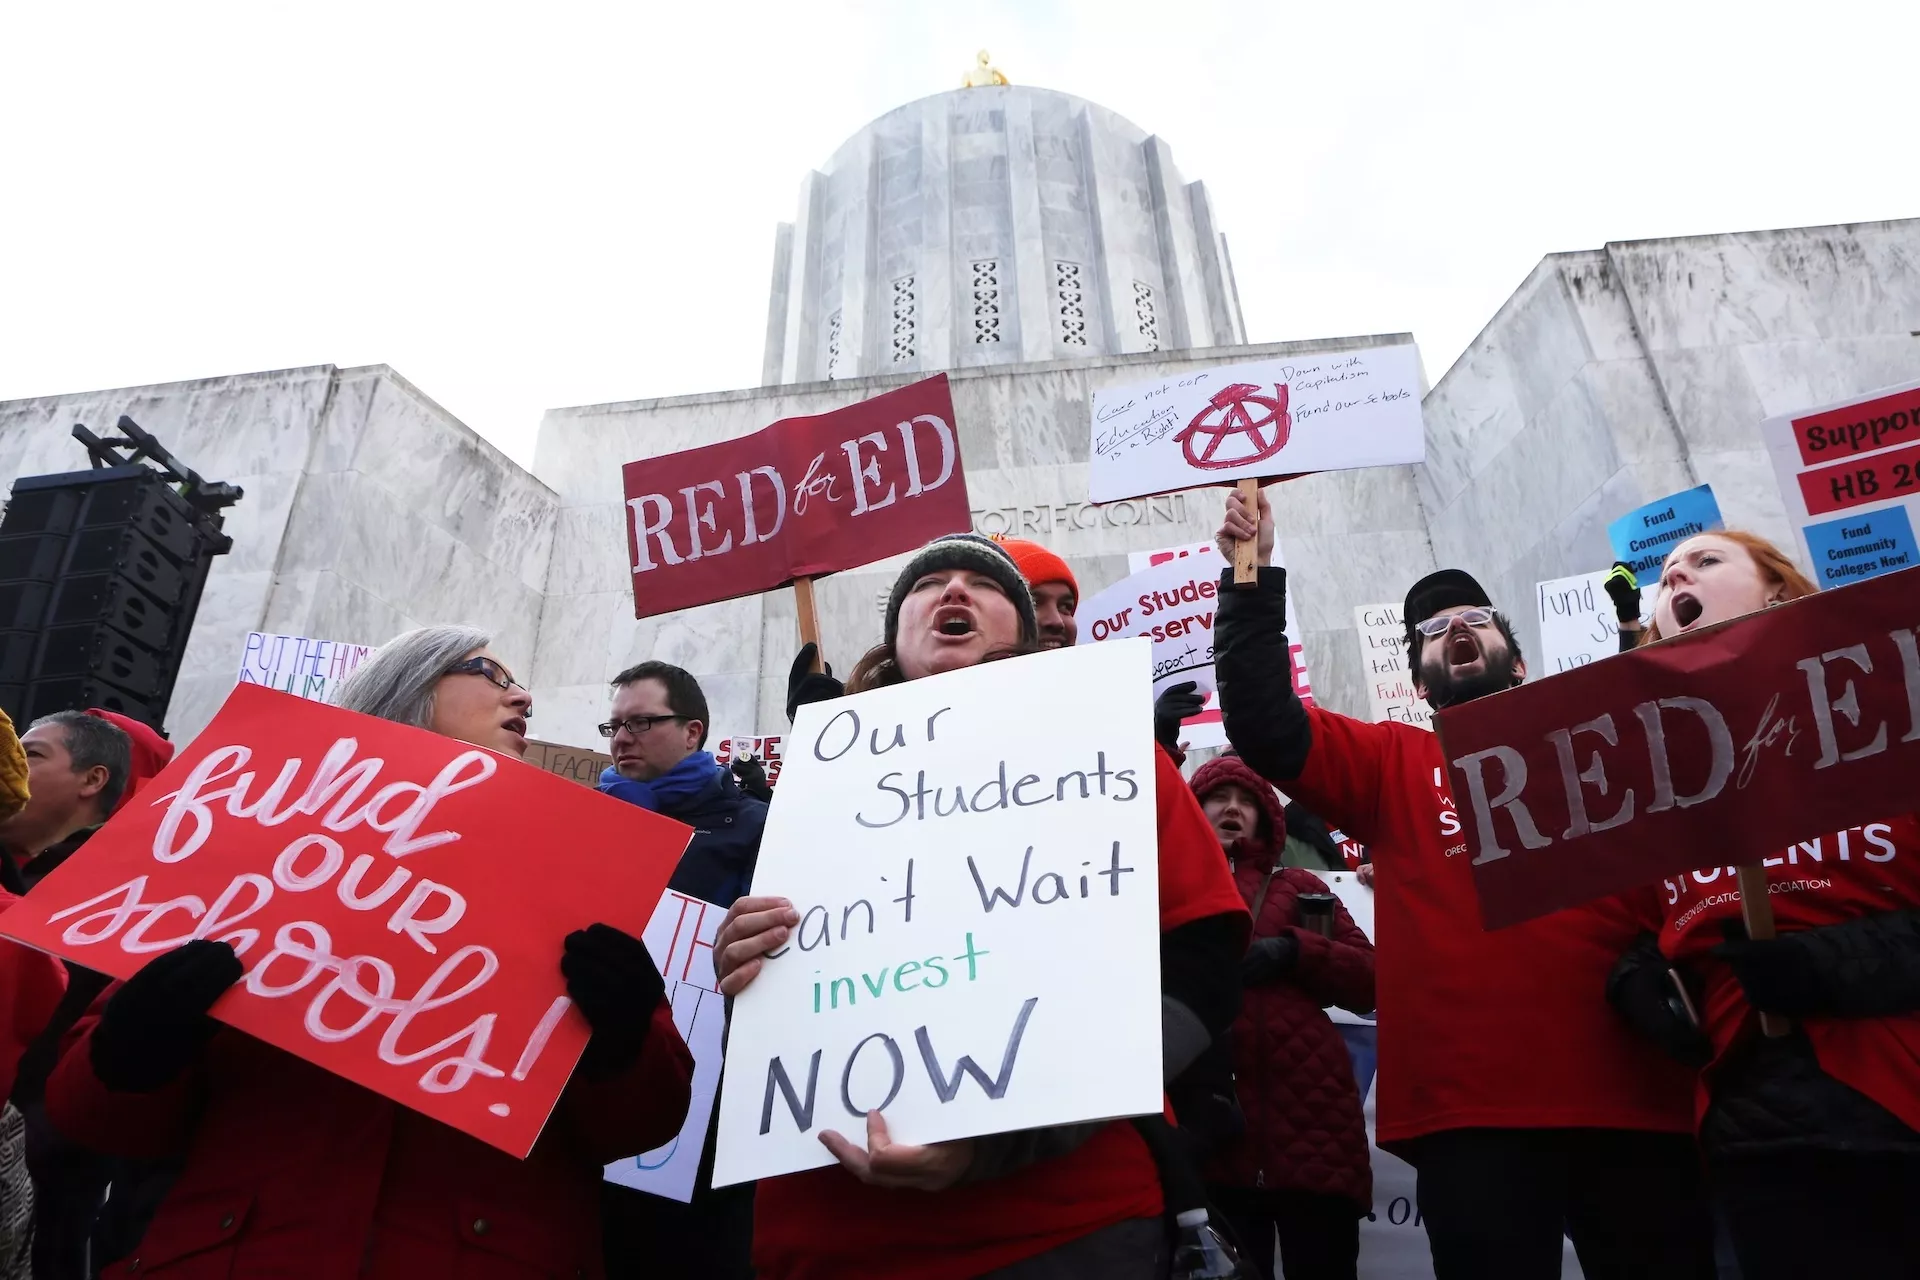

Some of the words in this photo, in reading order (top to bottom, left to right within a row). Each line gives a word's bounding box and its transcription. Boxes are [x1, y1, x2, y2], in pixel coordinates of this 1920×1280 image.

[1280, 365, 1321, 382] Down
[1331, 357, 1363, 370] with
[1145, 384, 1170, 400] not
[626, 465, 788, 574] RED
[792, 450, 842, 516] for
[839, 414, 957, 517] ED
[1829, 468, 1879, 503] HB
[974, 496, 1178, 538] OREGON
[1629, 522, 1703, 552] Community
[1643, 507, 1676, 527] Fund
[1841, 524, 1872, 540] Fund
[1825, 560, 1877, 579] Colleges
[1881, 551, 1910, 568] Now!
[1827, 538, 1896, 561] Community
[1363, 608, 1398, 627] Call
[1540, 580, 1595, 622] Fund
[242, 632, 290, 671] PUT
[293, 637, 331, 678] THE
[1371, 658, 1400, 674] tell
[1376, 682, 1415, 707] Fully
[813, 706, 951, 762] Our
[150, 736, 497, 864] fund
[855, 750, 1139, 828] Students
[1452, 695, 1736, 867] RED
[1736, 692, 1802, 790] for
[271, 832, 468, 955] OUR
[763, 857, 917, 959] an't
[966, 840, 1136, 913] Wait
[813, 931, 990, 1014] invest
[758, 996, 1039, 1136] NOW
